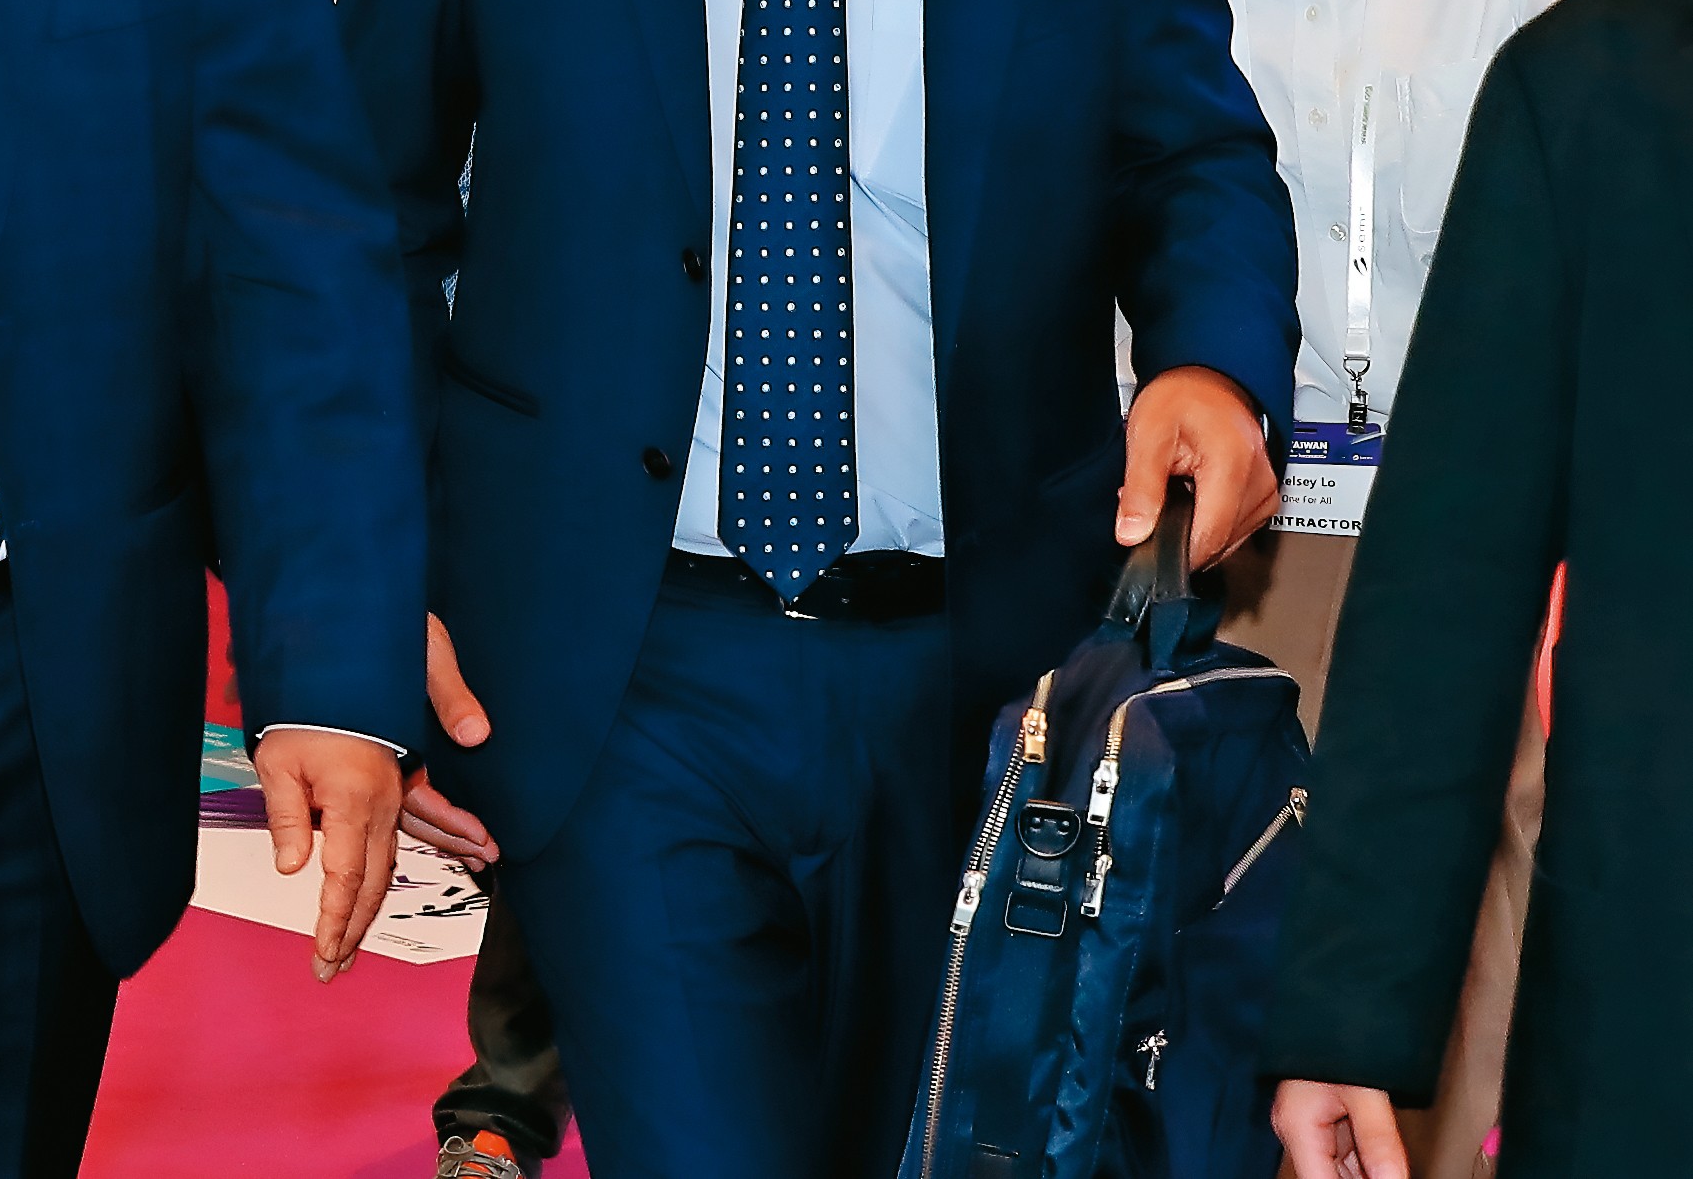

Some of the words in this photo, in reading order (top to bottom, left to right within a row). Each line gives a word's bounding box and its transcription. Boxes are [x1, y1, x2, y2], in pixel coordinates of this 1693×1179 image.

[1283, 475, 1318, 490] elsey
[1321, 477, 1336, 488] Lo
[1281, 494, 1300, 504] One
[1319, 497, 1332, 505] All
[1271, 515, 1362, 531] NTRACTOR
